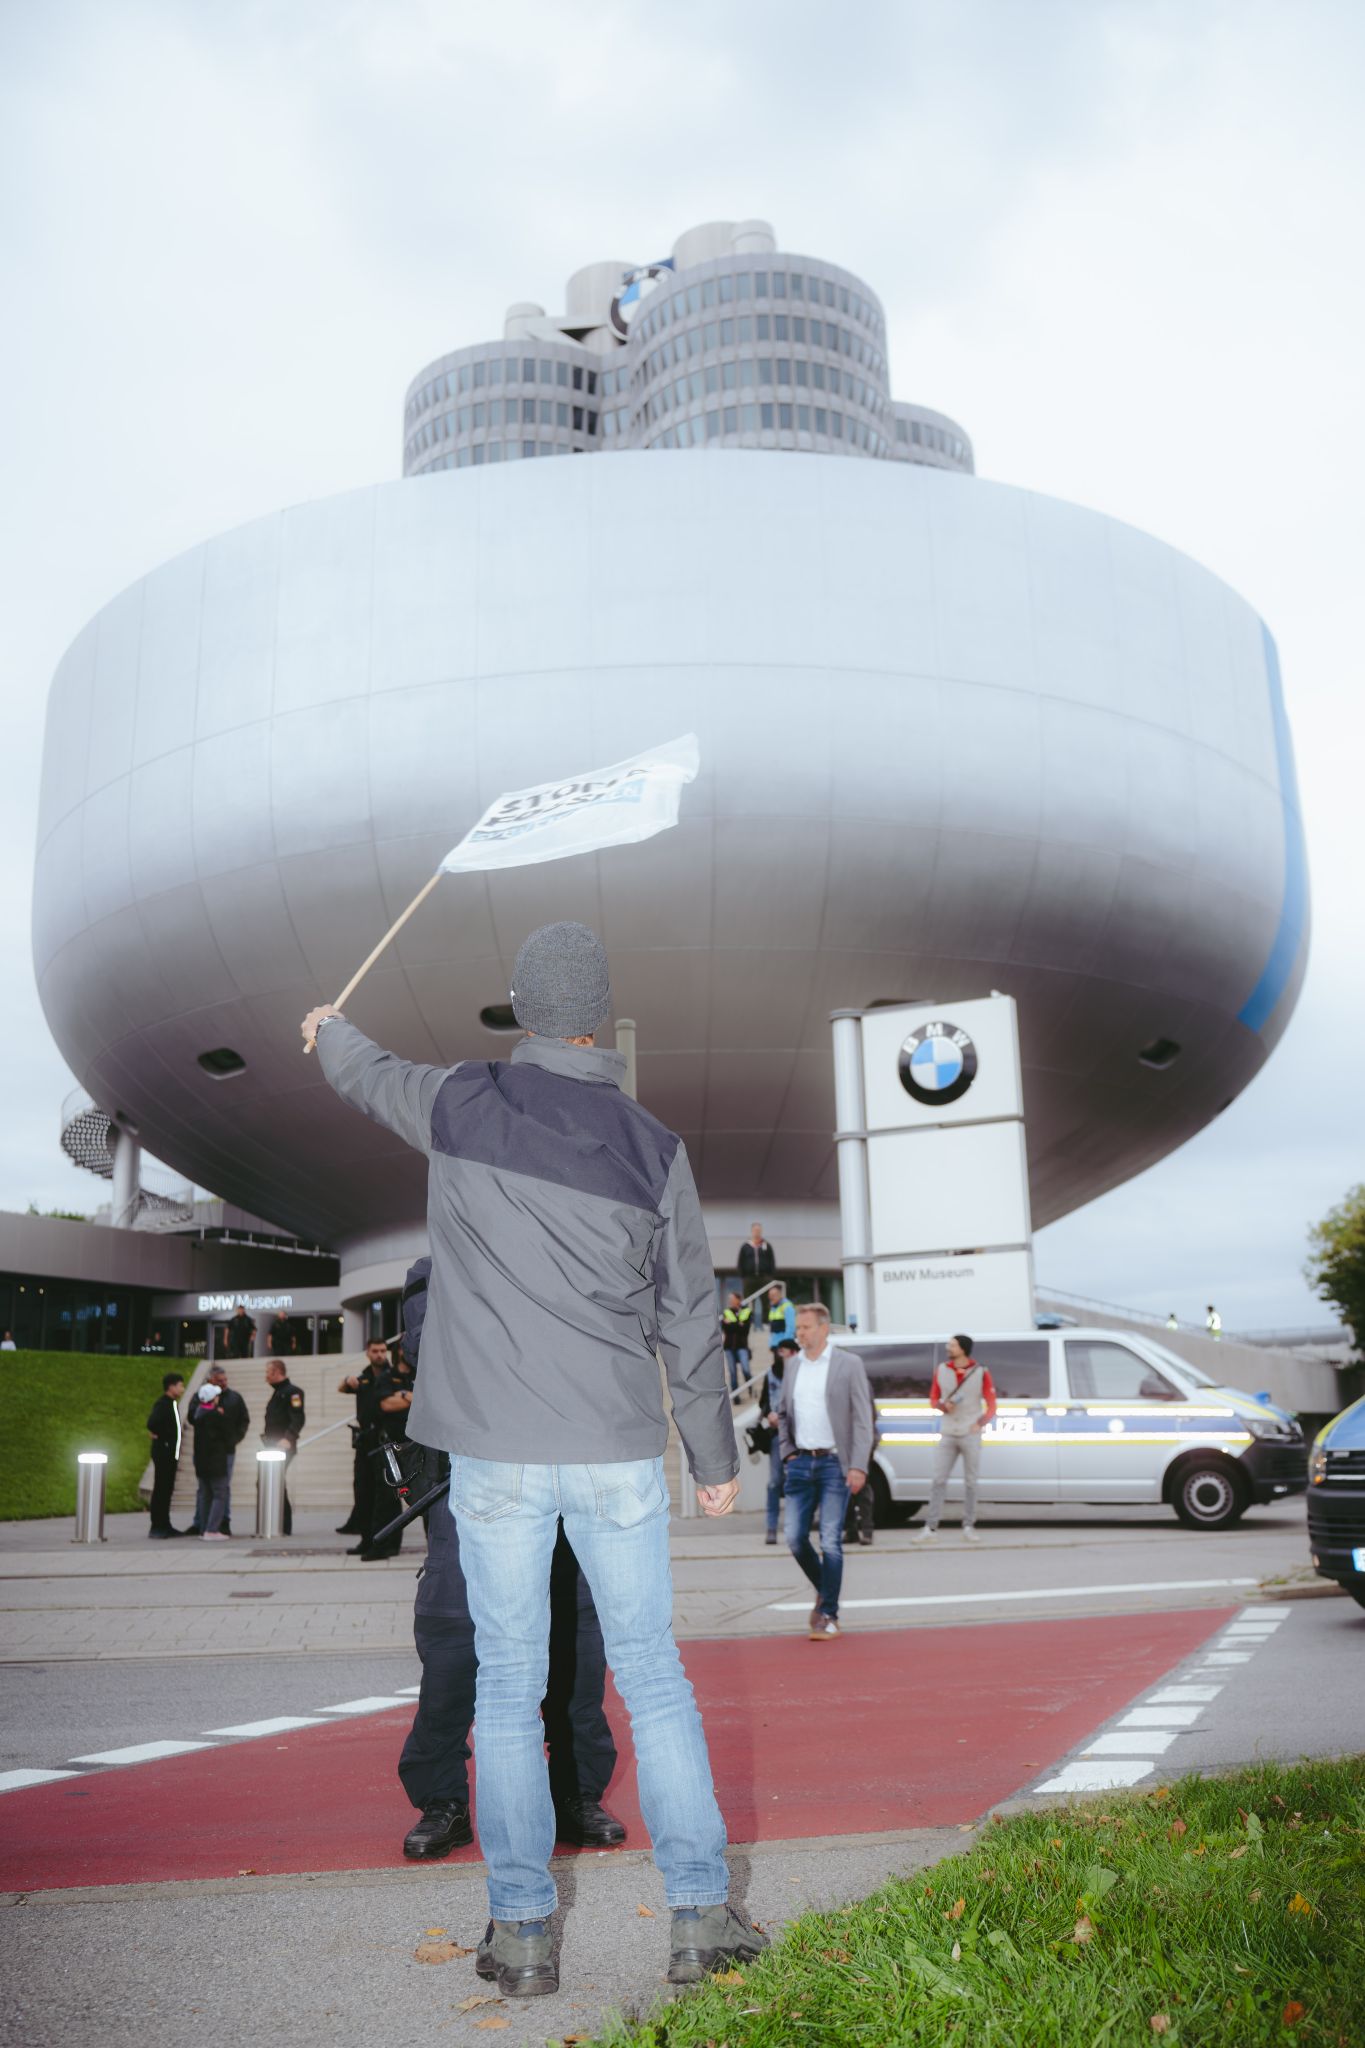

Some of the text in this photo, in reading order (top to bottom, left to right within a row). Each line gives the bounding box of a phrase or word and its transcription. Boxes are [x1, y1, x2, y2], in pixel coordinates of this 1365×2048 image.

[902, 1022, 971, 1054] BMW
[883, 1268, 975, 1282] BMW Museum
[198, 1294, 292, 1311] BMW Museum
